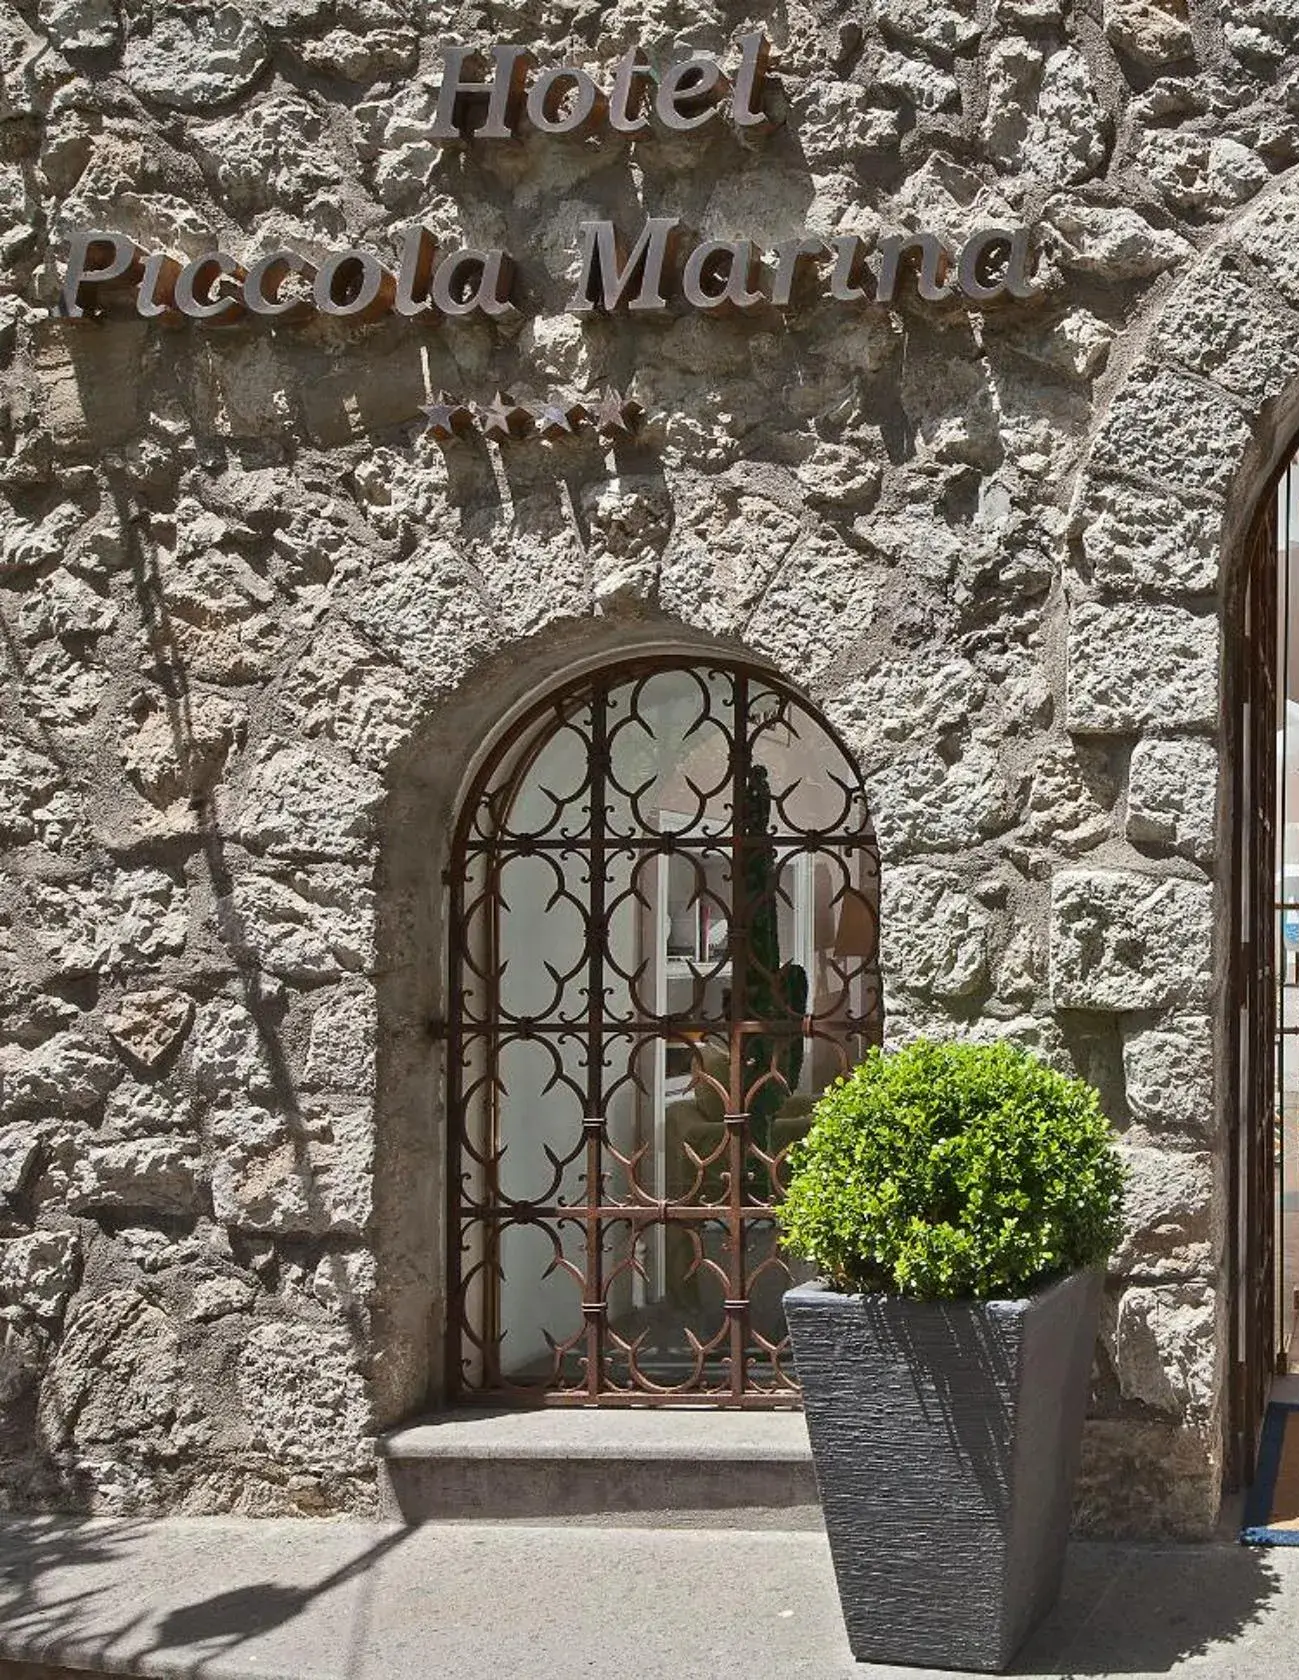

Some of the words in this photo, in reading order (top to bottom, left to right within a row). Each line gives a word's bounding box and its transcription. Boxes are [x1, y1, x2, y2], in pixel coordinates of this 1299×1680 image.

[430, 32, 769, 138] Hotel
[57, 225, 517, 318] Piccola
[564, 216, 1037, 312] Marina
